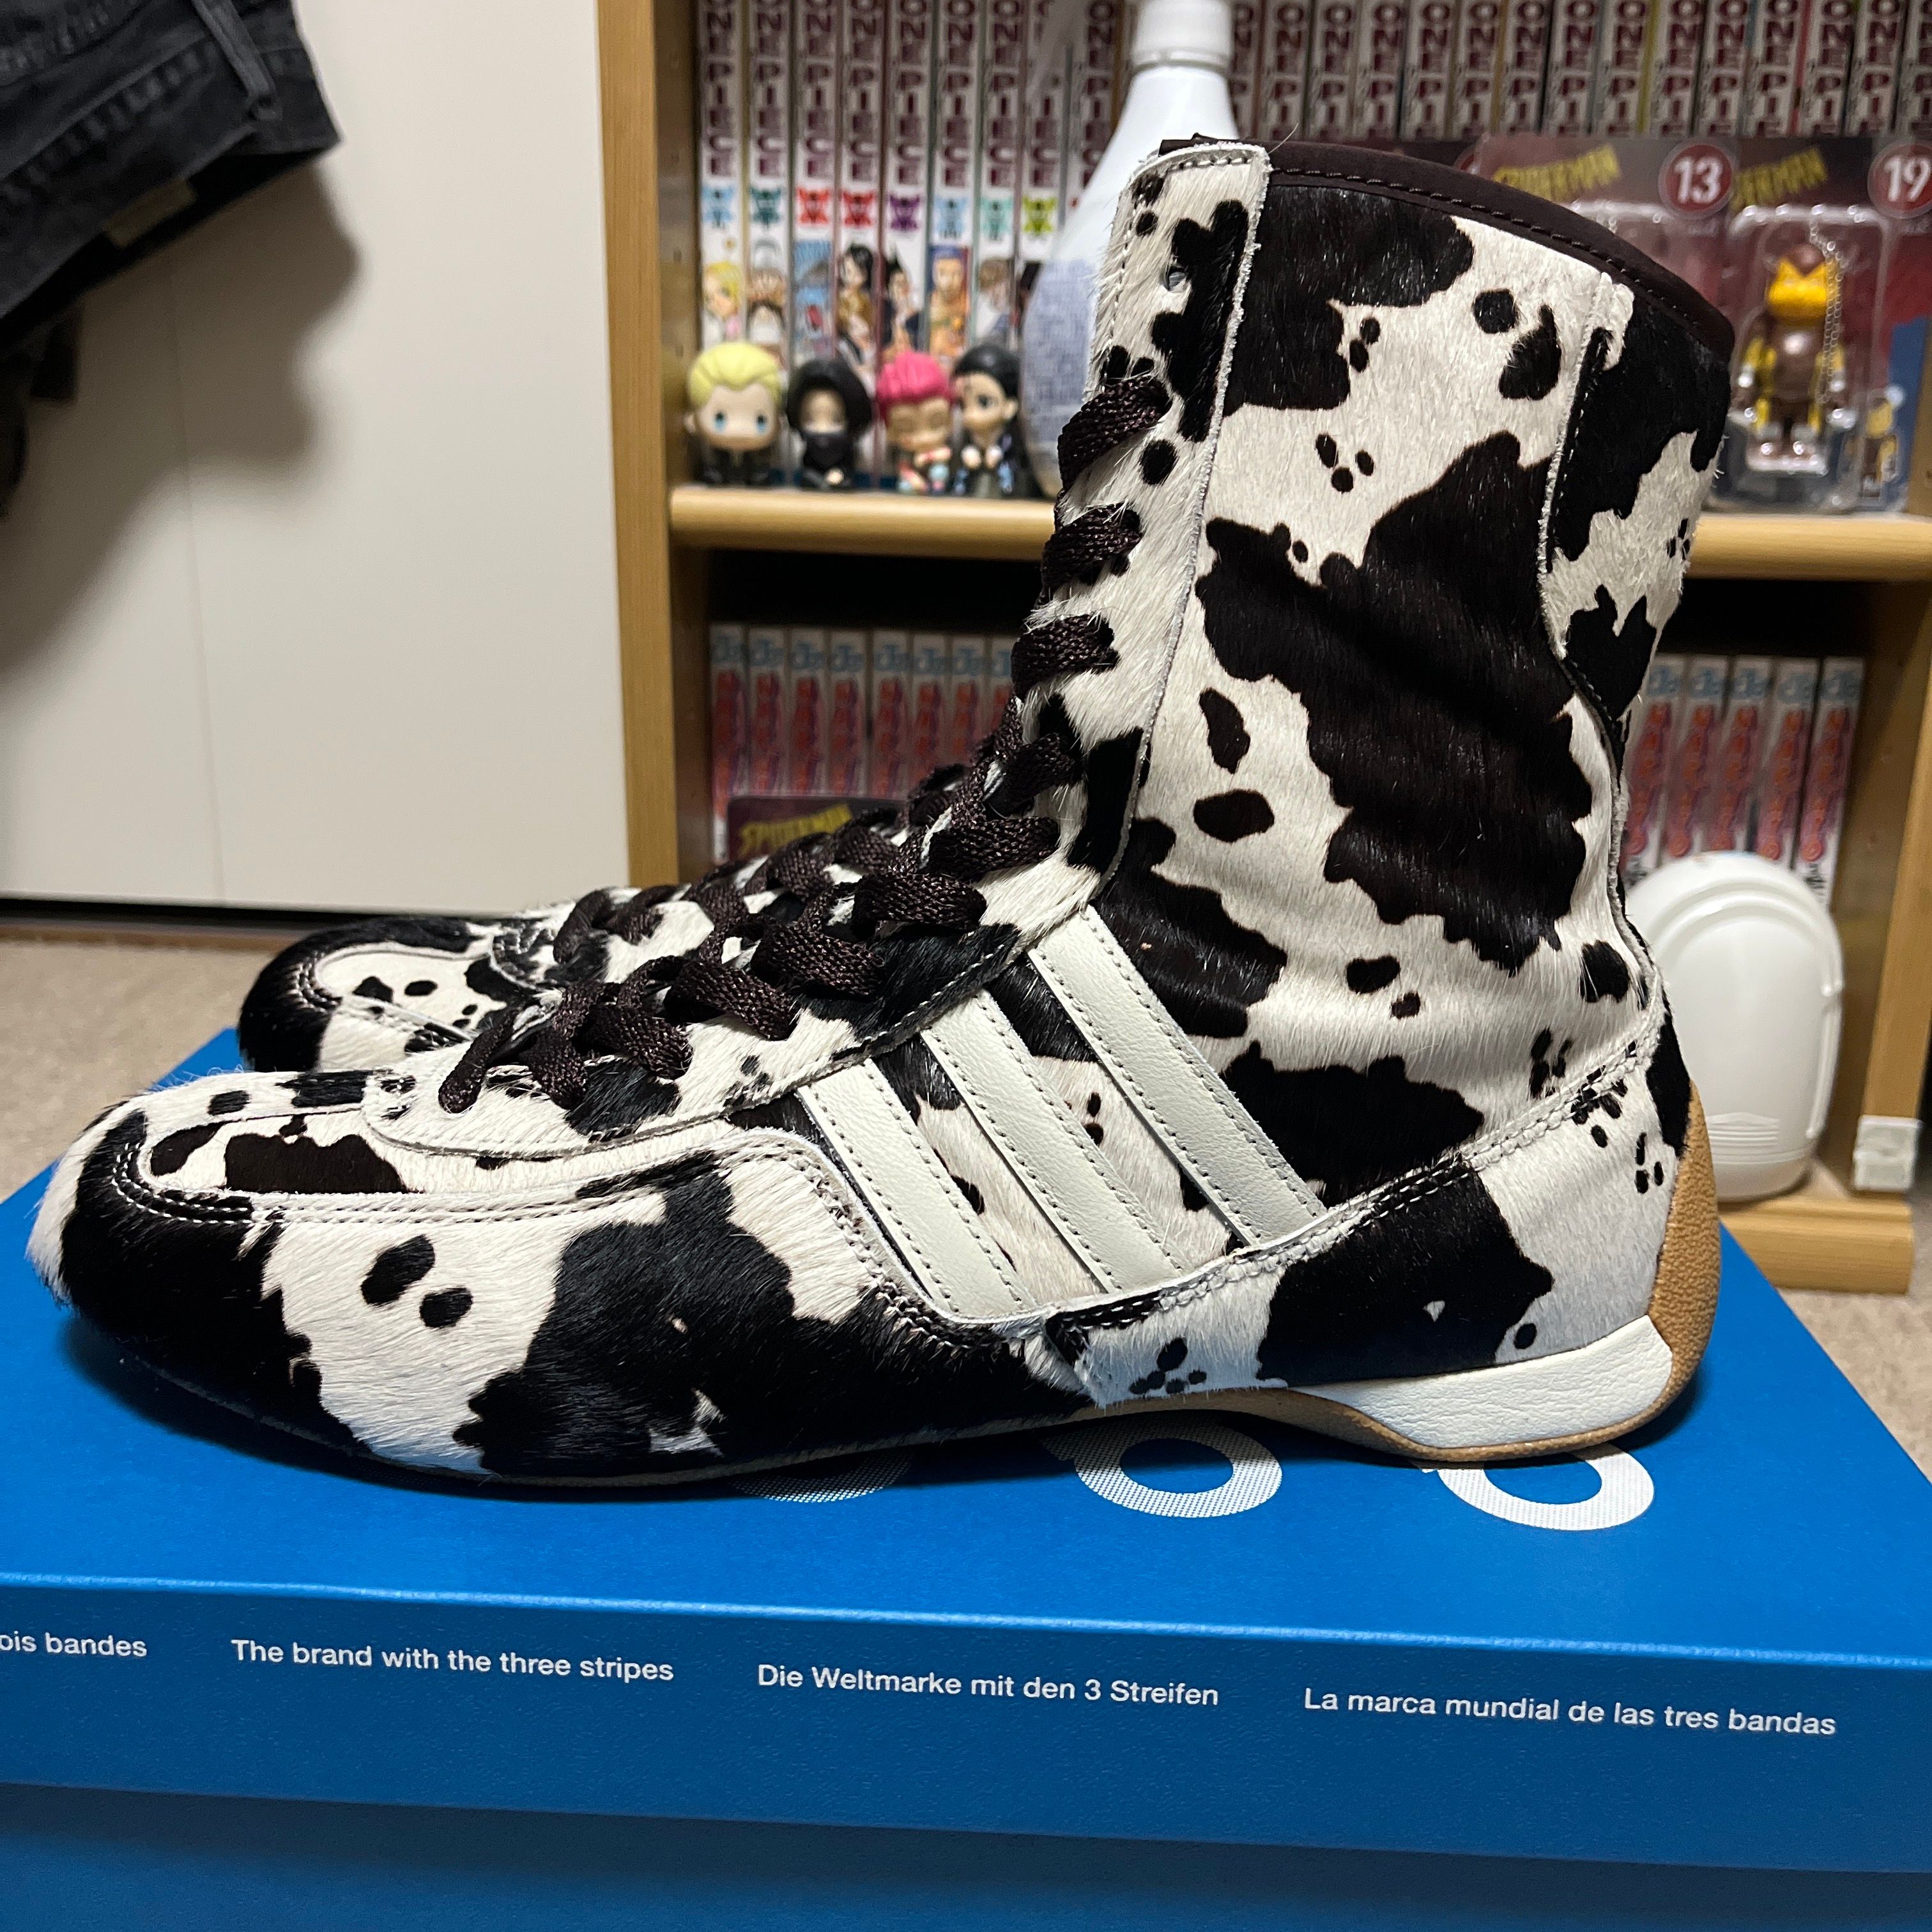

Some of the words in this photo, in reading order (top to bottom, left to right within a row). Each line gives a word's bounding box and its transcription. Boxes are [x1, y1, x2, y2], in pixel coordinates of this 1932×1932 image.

[1674, 156, 1723, 204] 13
[1882, 157, 1930, 203] 19
[45, 1632, 147, 1657] bandes
[231, 1639, 283, 1662] The
[293, 1642, 372, 1666] brand
[381, 1647, 439, 1670] with
[447, 1650, 491, 1673] the
[500, 1652, 571, 1676] three
[579, 1656, 673, 1683] stripes
[758, 1664, 803, 1687] Die
[811, 1666, 962, 1694] Weltmarke
[971, 1674, 1014, 1697] mit
[1023, 1676, 1075, 1700] den
[1084, 1678, 1101, 1701] 3
[1110, 1680, 1218, 1706] Streifen
[1305, 1687, 1338, 1710] La
[1348, 1694, 1436, 1715] marca
[1445, 1695, 1559, 1722] mundial
[1568, 1701, 1605, 1723] de
[1614, 1702, 1655, 1726] las
[1664, 1705, 1719, 1729] tres
[1728, 1708, 1836, 1736] bandas
